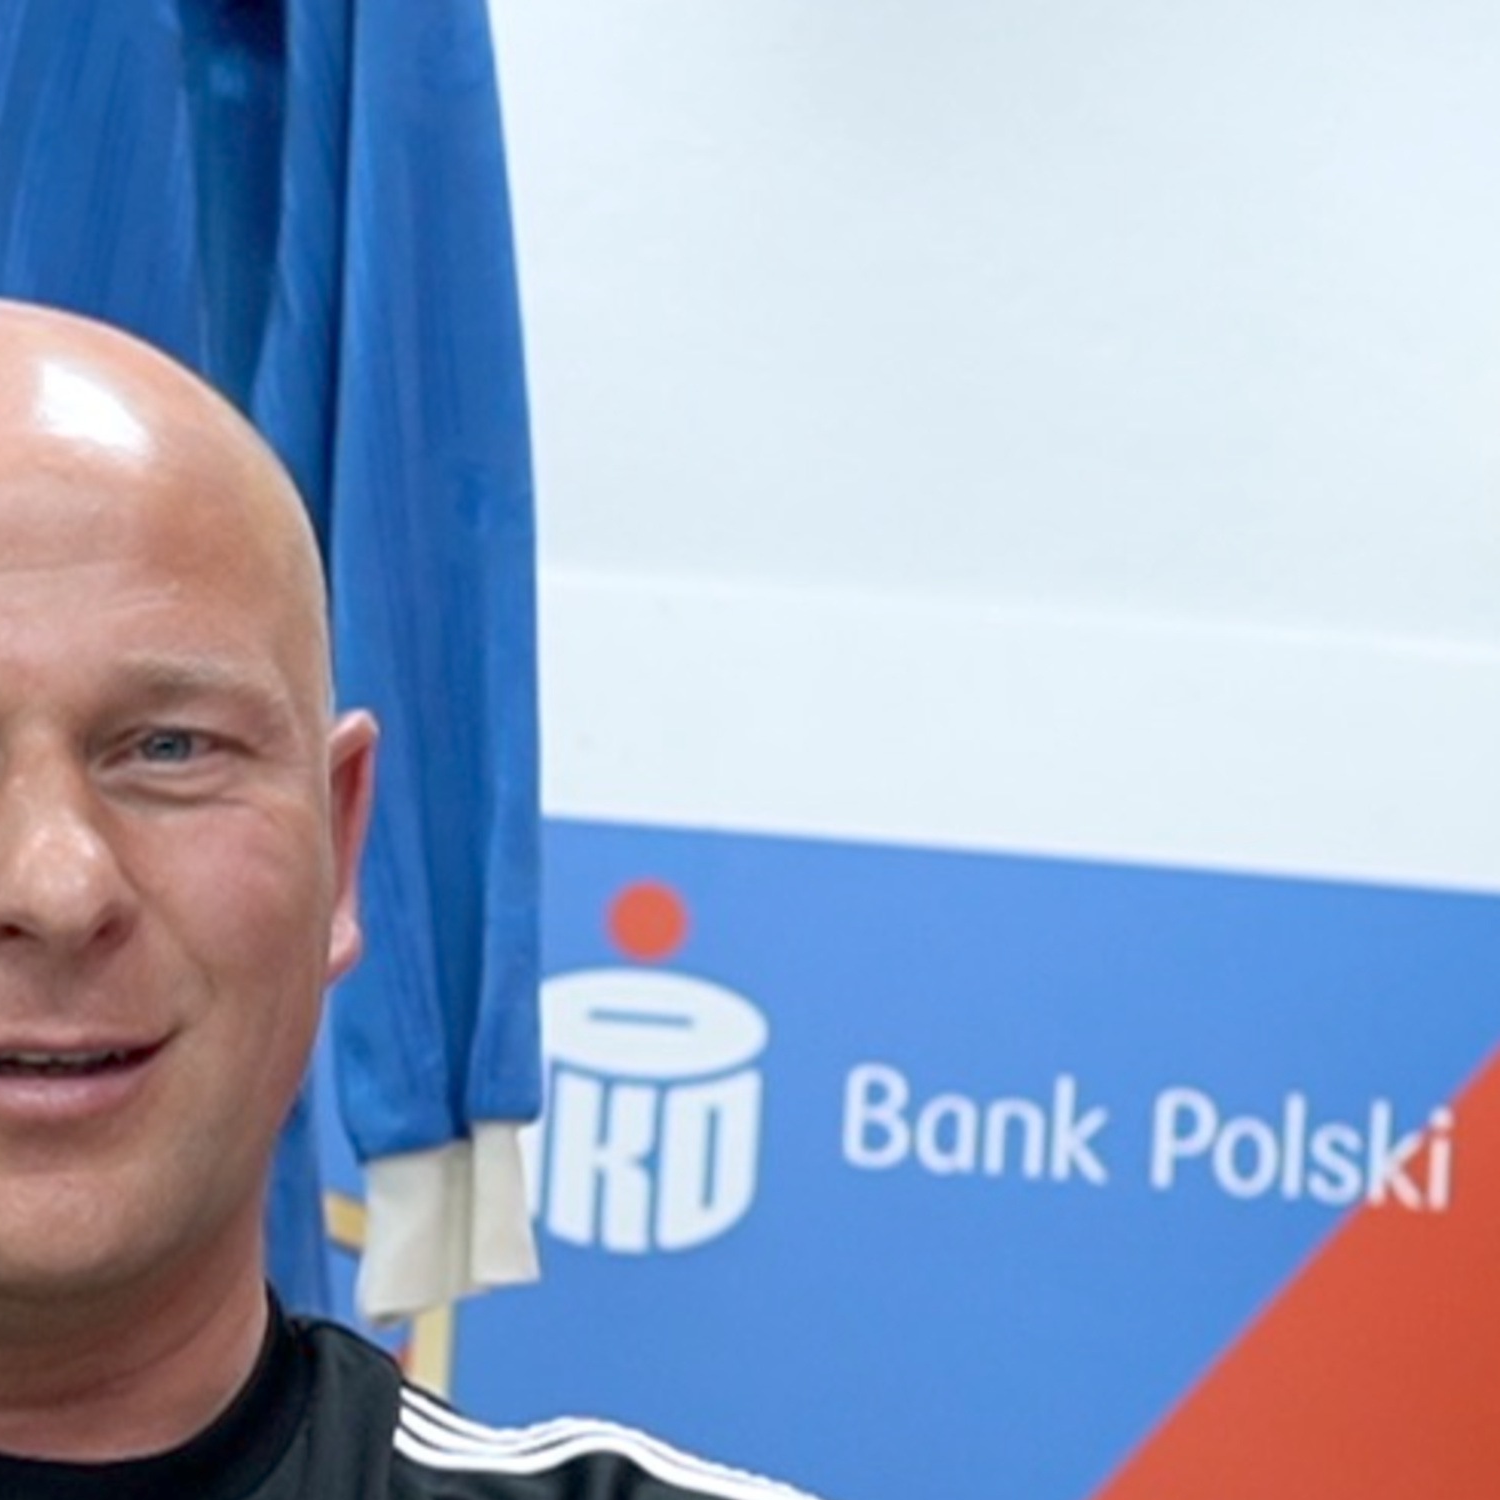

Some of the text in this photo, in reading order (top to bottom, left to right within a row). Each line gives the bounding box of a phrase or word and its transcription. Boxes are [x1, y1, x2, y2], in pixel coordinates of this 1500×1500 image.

[518, 1062, 1453, 1254] KO Bank Polski
